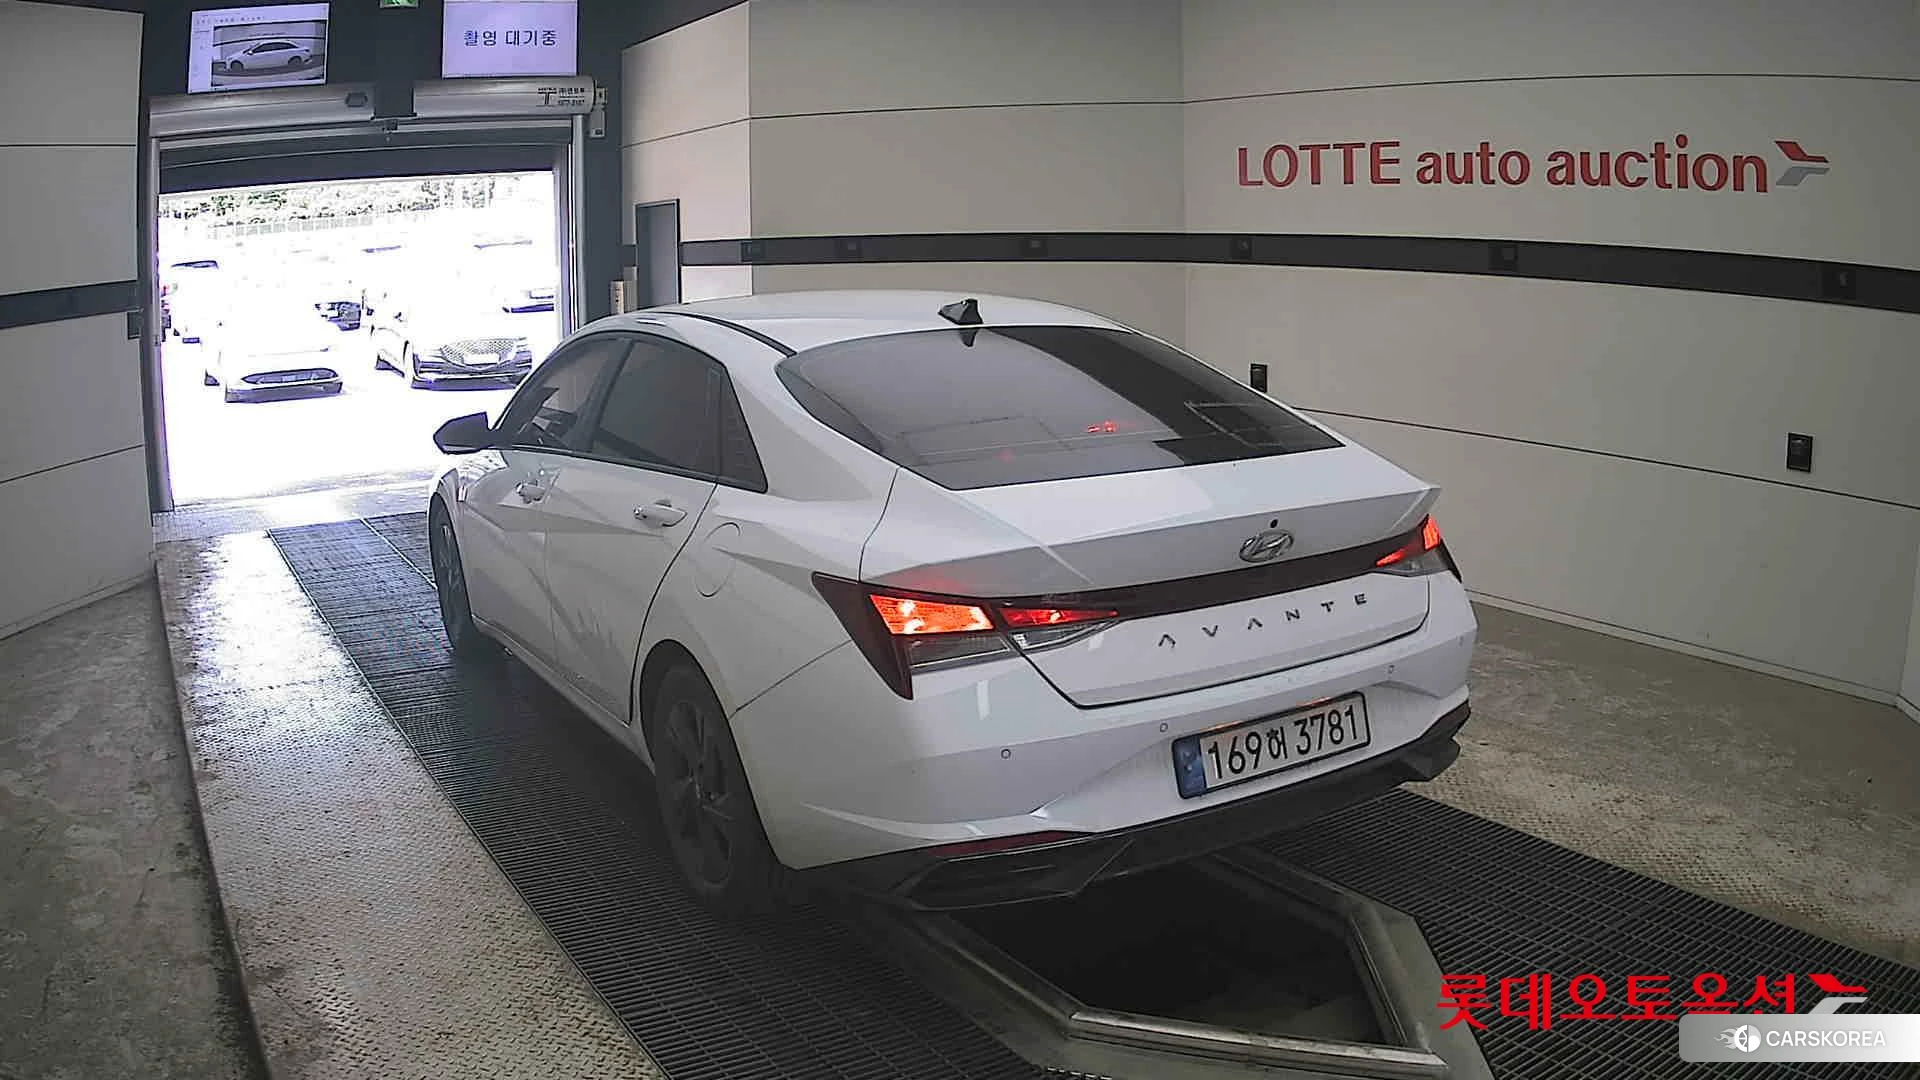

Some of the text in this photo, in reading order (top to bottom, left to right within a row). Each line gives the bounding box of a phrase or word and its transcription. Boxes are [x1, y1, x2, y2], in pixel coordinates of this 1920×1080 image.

[505, 30, 556, 46] 대기중
[1238, 135, 1768, 193] LOTTE auto auction
[1158, 593, 1367, 648] AVANTE
[1294, 704, 1358, 755] 3781
